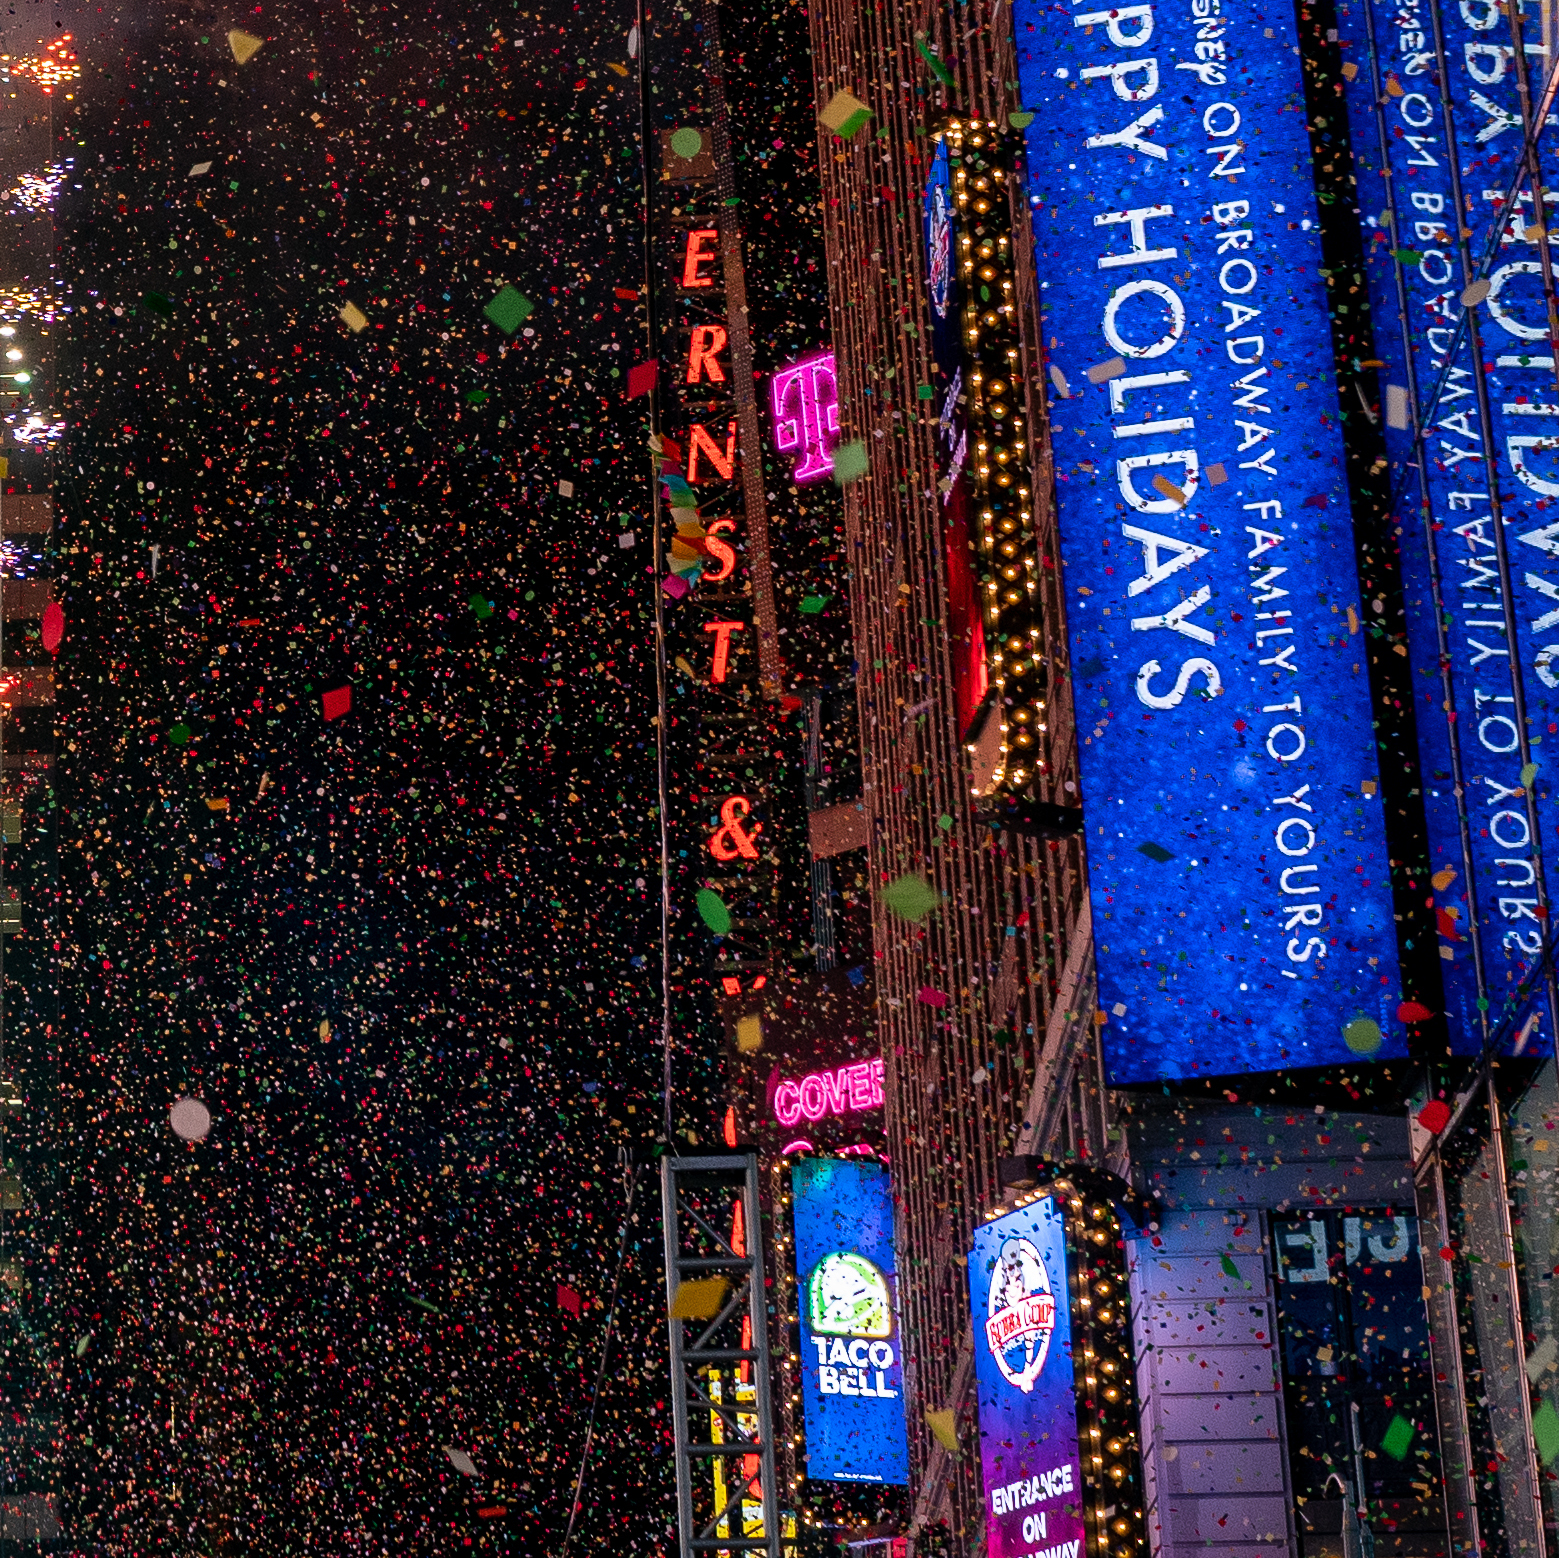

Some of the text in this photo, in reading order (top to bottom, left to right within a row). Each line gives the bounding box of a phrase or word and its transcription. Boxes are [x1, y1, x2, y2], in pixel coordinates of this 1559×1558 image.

[1201, 99, 1247, 177] ON
[1211, 197, 1279, 477] BROADWAY
[681, 228, 745, 685] ERNST
[1093, 204, 1225, 712] HOLIDAYS
[1241, 497, 1301, 676] FAMILY
[1262, 692, 1307, 762] TO
[810, 1335, 894, 1370] TACO
[818, 1364, 897, 1399] BELL
[991, 1463, 1074, 1516] ENTRANCE
[1022, 1511, 1047, 1544] ON
